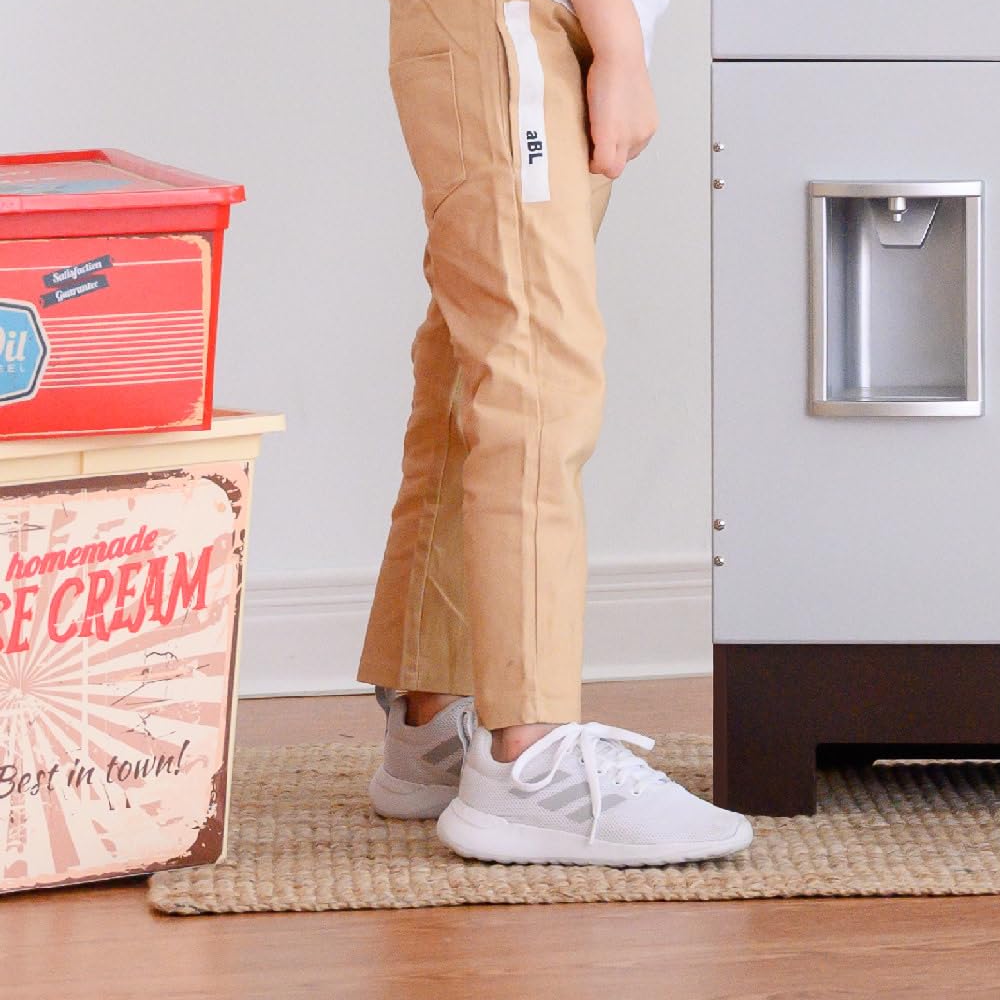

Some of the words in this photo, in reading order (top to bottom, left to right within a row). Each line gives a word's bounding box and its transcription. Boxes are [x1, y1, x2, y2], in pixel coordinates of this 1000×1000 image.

[52, 261, 102, 283] Satisfaction
[55, 281, 99, 302] Guarantee
[5, 524, 159, 582] homemade
[47, 544, 214, 644] CREAM
[0, 763, 60, 799] Best
[67, 758, 96, 788] in
[106, 739, 191, 784] town!
